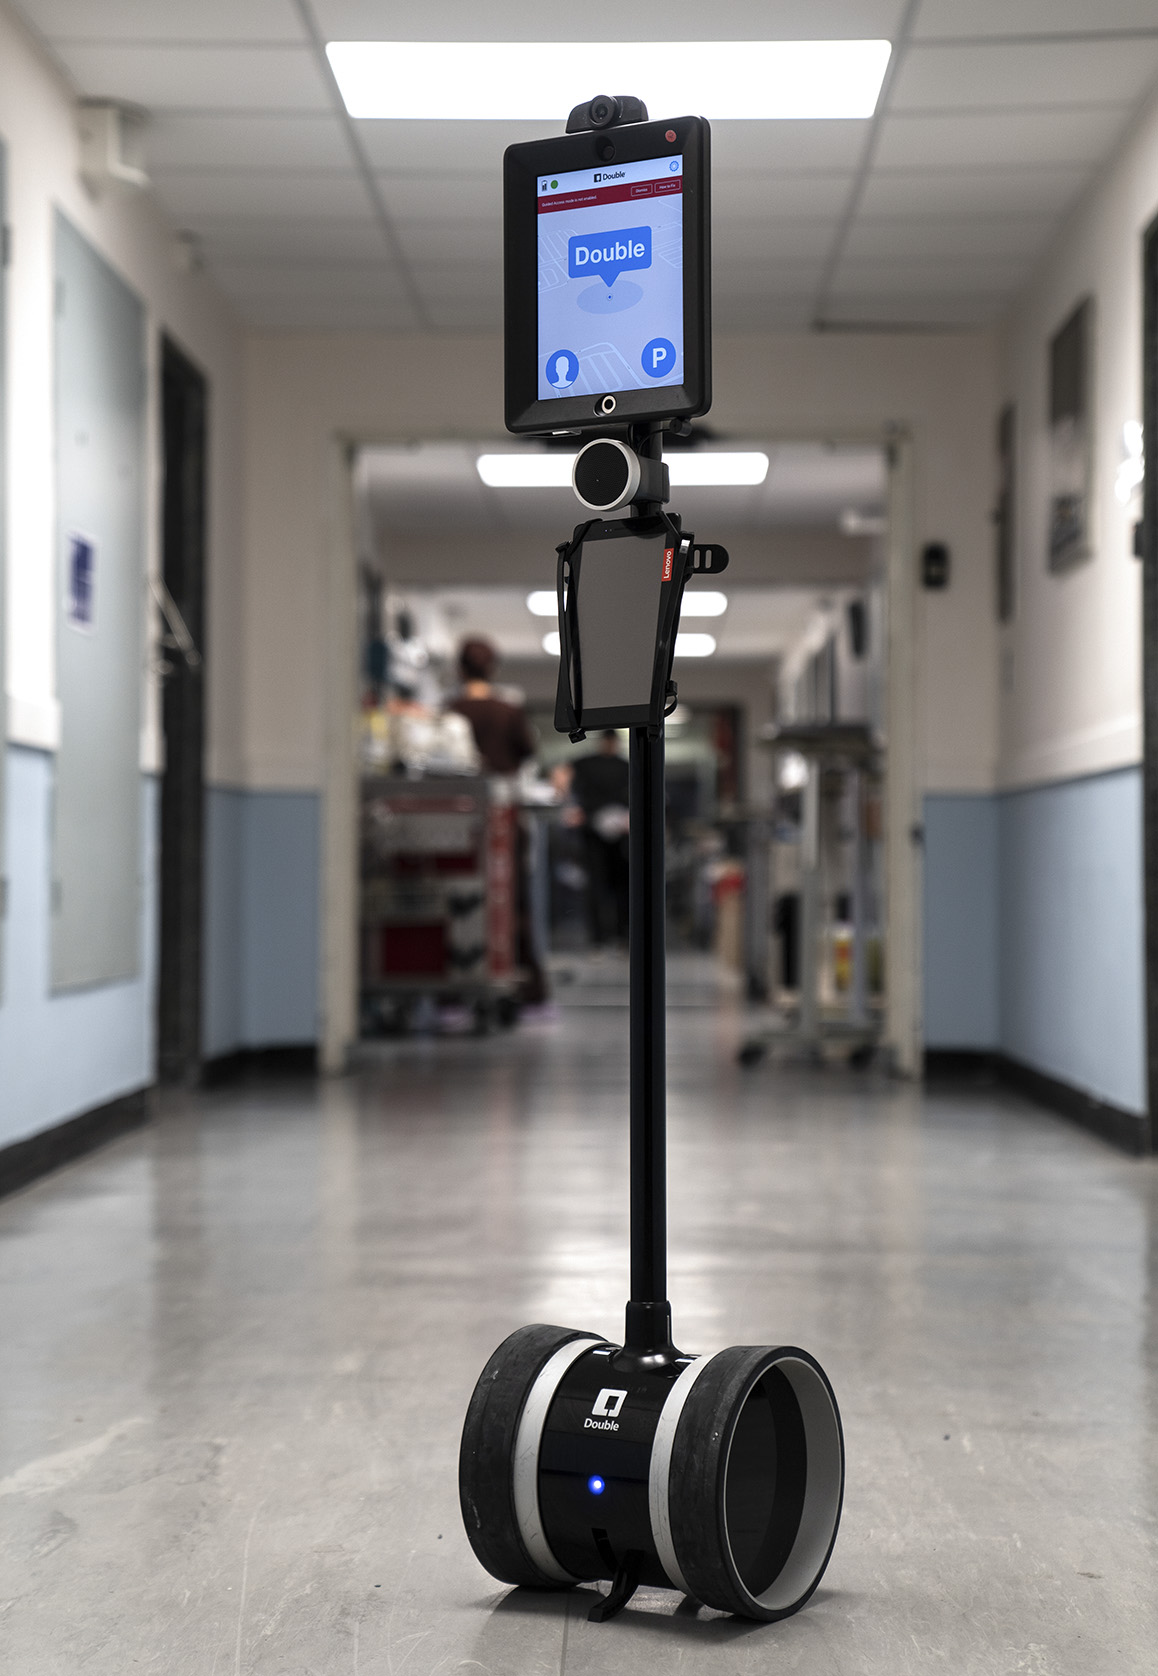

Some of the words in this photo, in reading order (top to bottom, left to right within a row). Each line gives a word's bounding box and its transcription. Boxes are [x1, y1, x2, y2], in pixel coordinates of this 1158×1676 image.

[603, 171, 626, 180] Double
[575, 240, 645, 266] Double
[652, 347, 667, 368] P
[663, 550, 672, 579] Lenovo
[583, 1417, 620, 1432] Double
